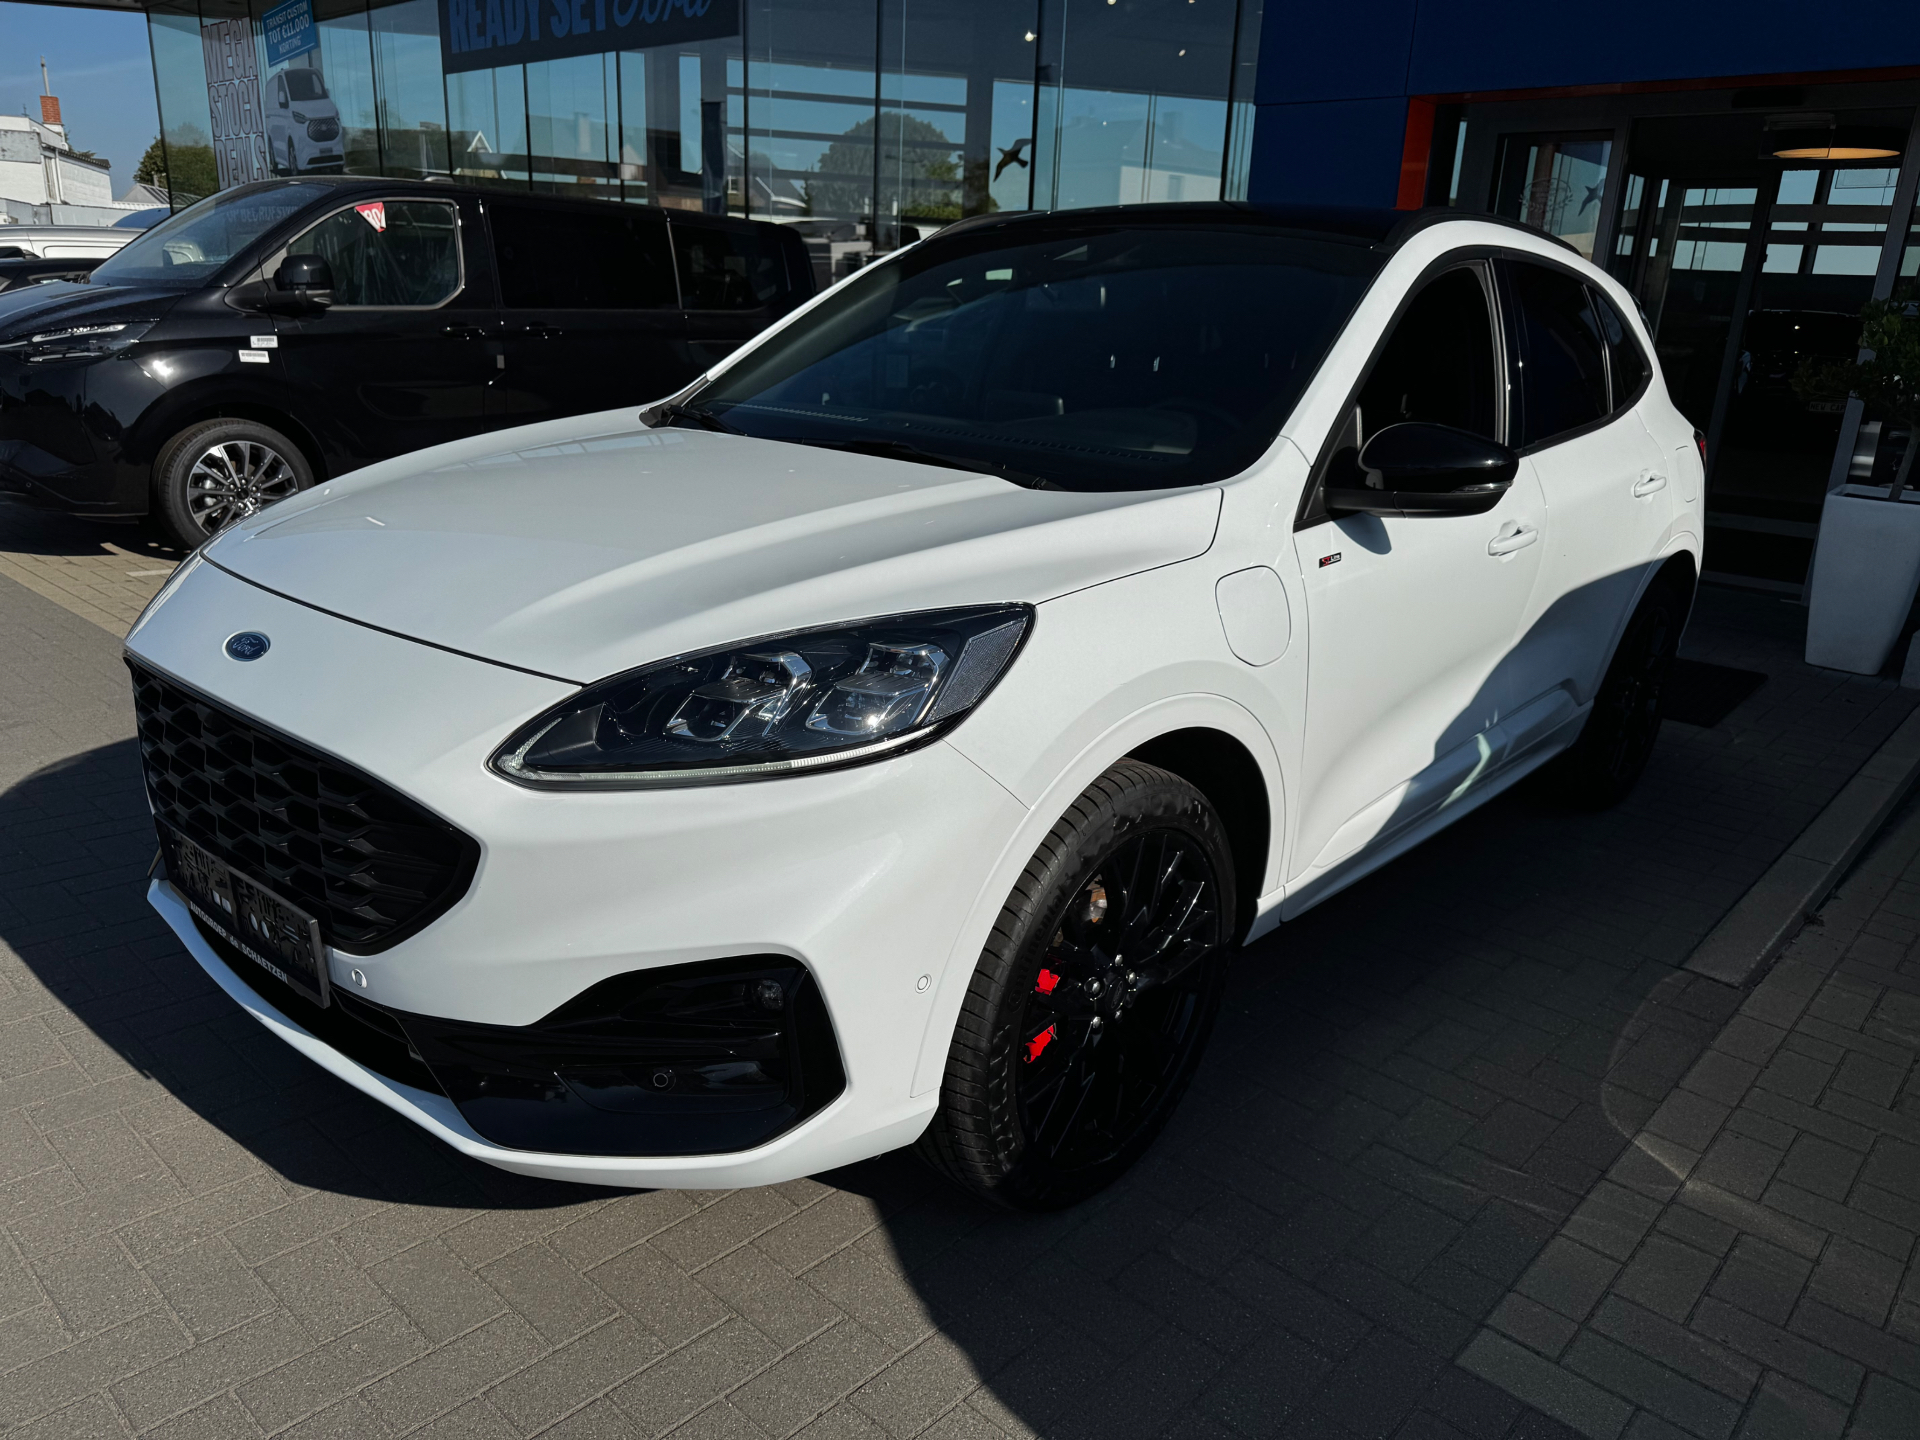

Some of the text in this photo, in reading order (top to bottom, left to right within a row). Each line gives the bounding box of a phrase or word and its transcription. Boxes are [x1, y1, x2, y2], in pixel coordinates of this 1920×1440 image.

[266, 1, 308, 29] TRANSIT CUSTOM
[268, 14, 310, 45] TOT €11.000
[449, 0, 540, 54] READY
[201, 15, 258, 84] MEGA
[208, 78, 264, 138] STOCK
[214, 134, 270, 191] DEALS
[1811, 402, 1826, 411] NEW
